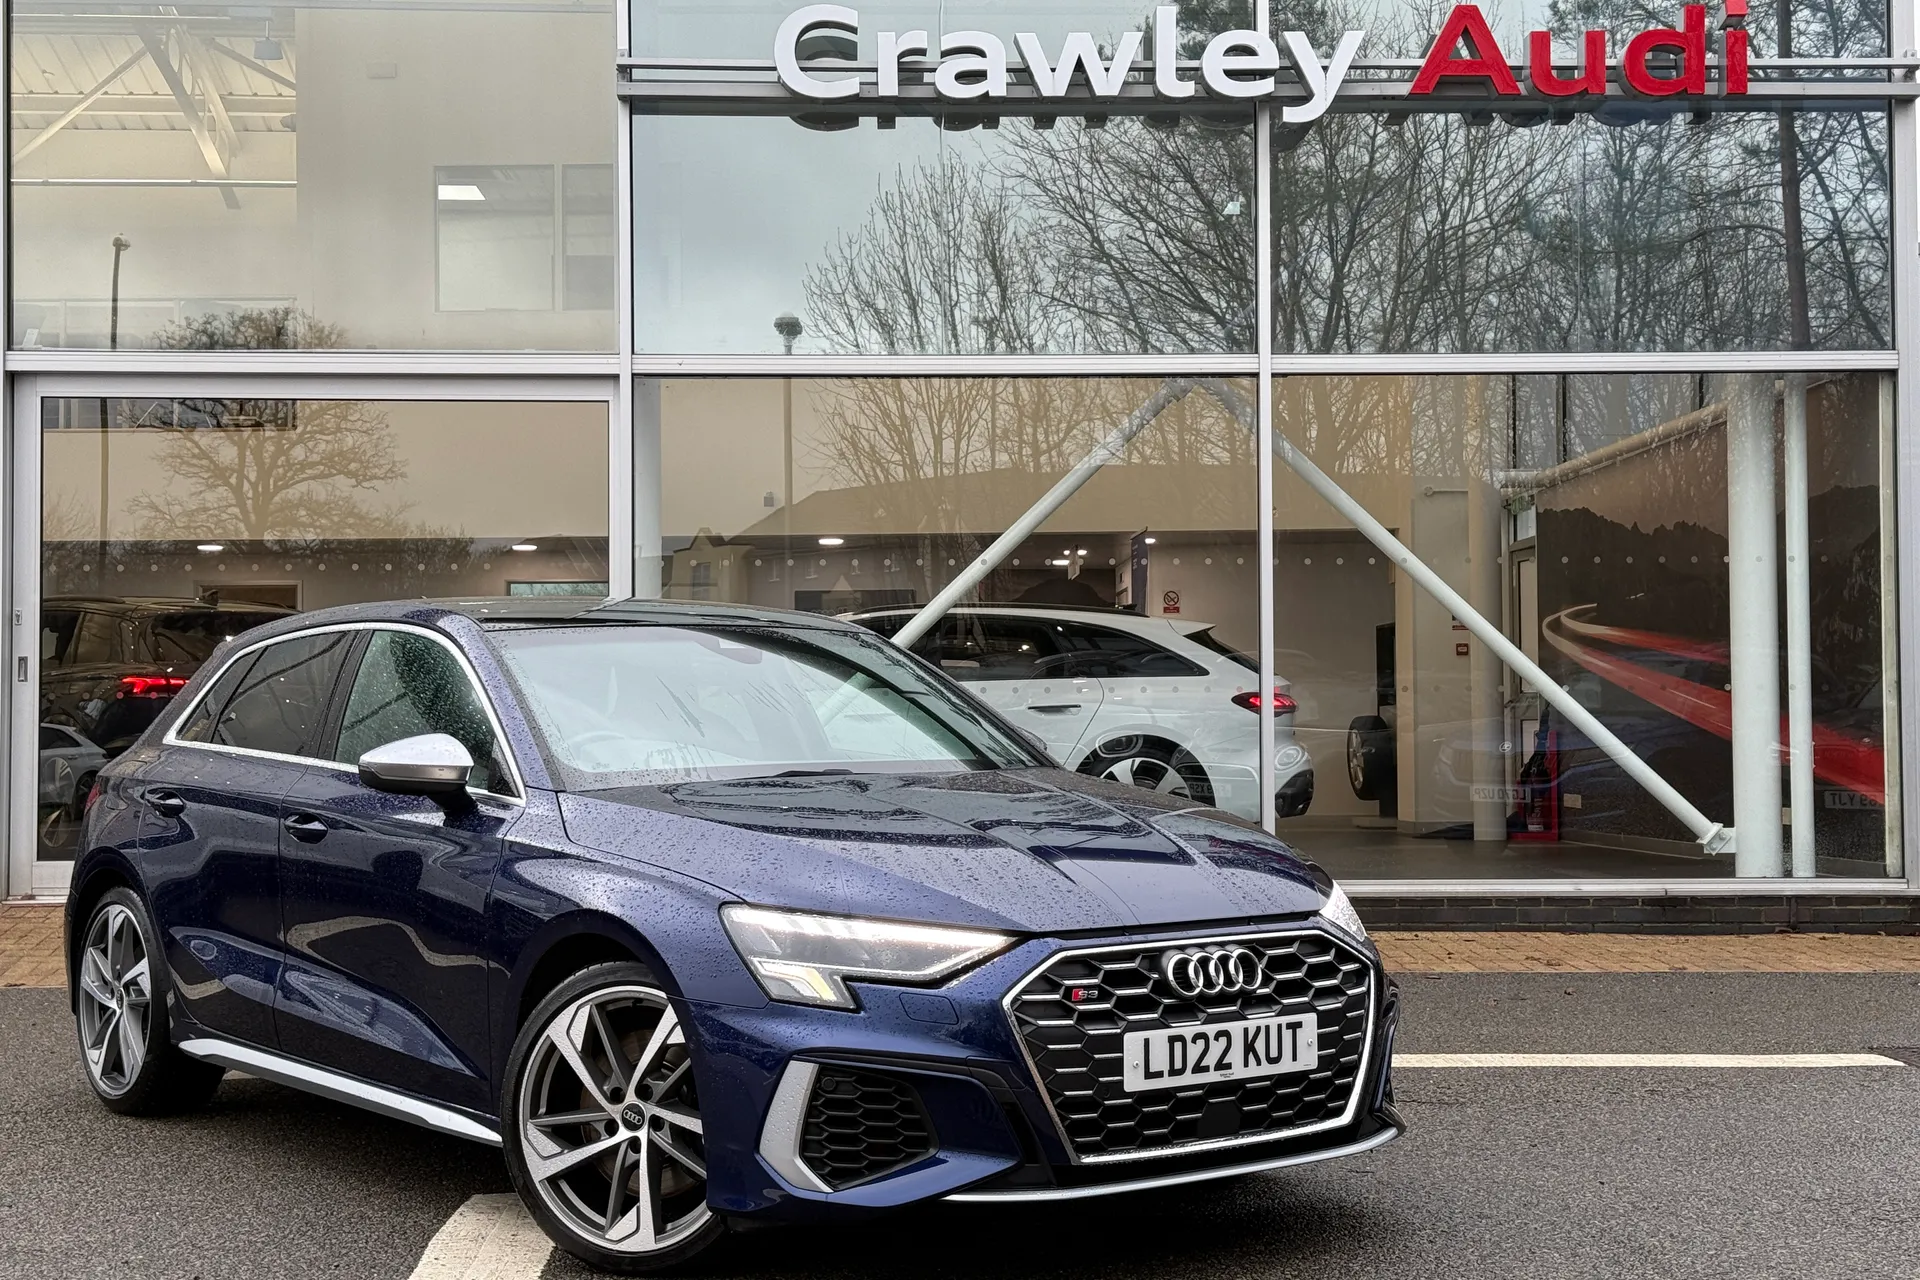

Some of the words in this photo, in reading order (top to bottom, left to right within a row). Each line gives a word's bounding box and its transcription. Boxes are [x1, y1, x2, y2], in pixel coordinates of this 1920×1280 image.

[774, 4, 1364, 123] Crawley
[1409, 0, 1748, 96] Audi
[1077, 990, 1098, 999] S3
[1143, 1029, 1233, 1080] LD22
[1243, 1021, 1303, 1068] KUT
